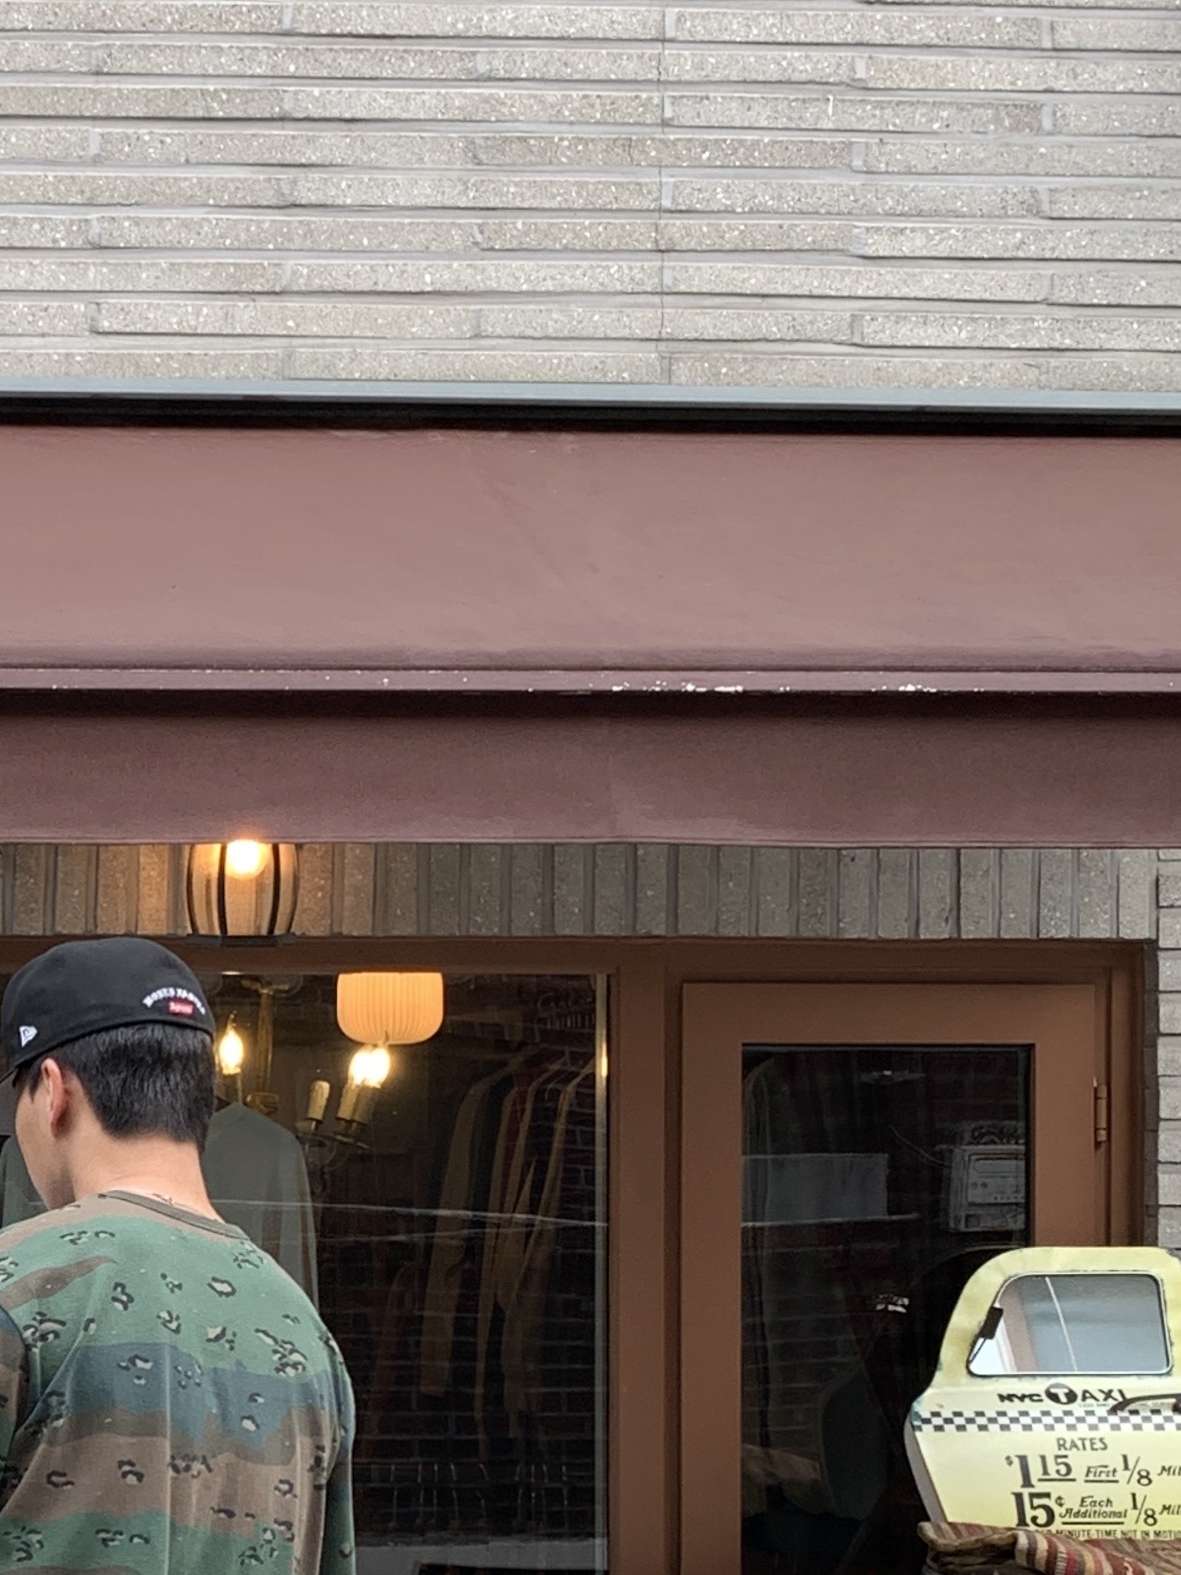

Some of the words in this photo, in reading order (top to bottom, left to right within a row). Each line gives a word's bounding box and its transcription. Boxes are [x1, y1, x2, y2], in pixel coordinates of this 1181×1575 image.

[997, 1393, 1044, 1403] NYC
[1056, 1437, 1108, 1451] RATES
[1085, 1464, 1118, 1478] First
[1079, 1495, 1113, 1508] Each
[1059, 1508, 1128, 1519] Additional
